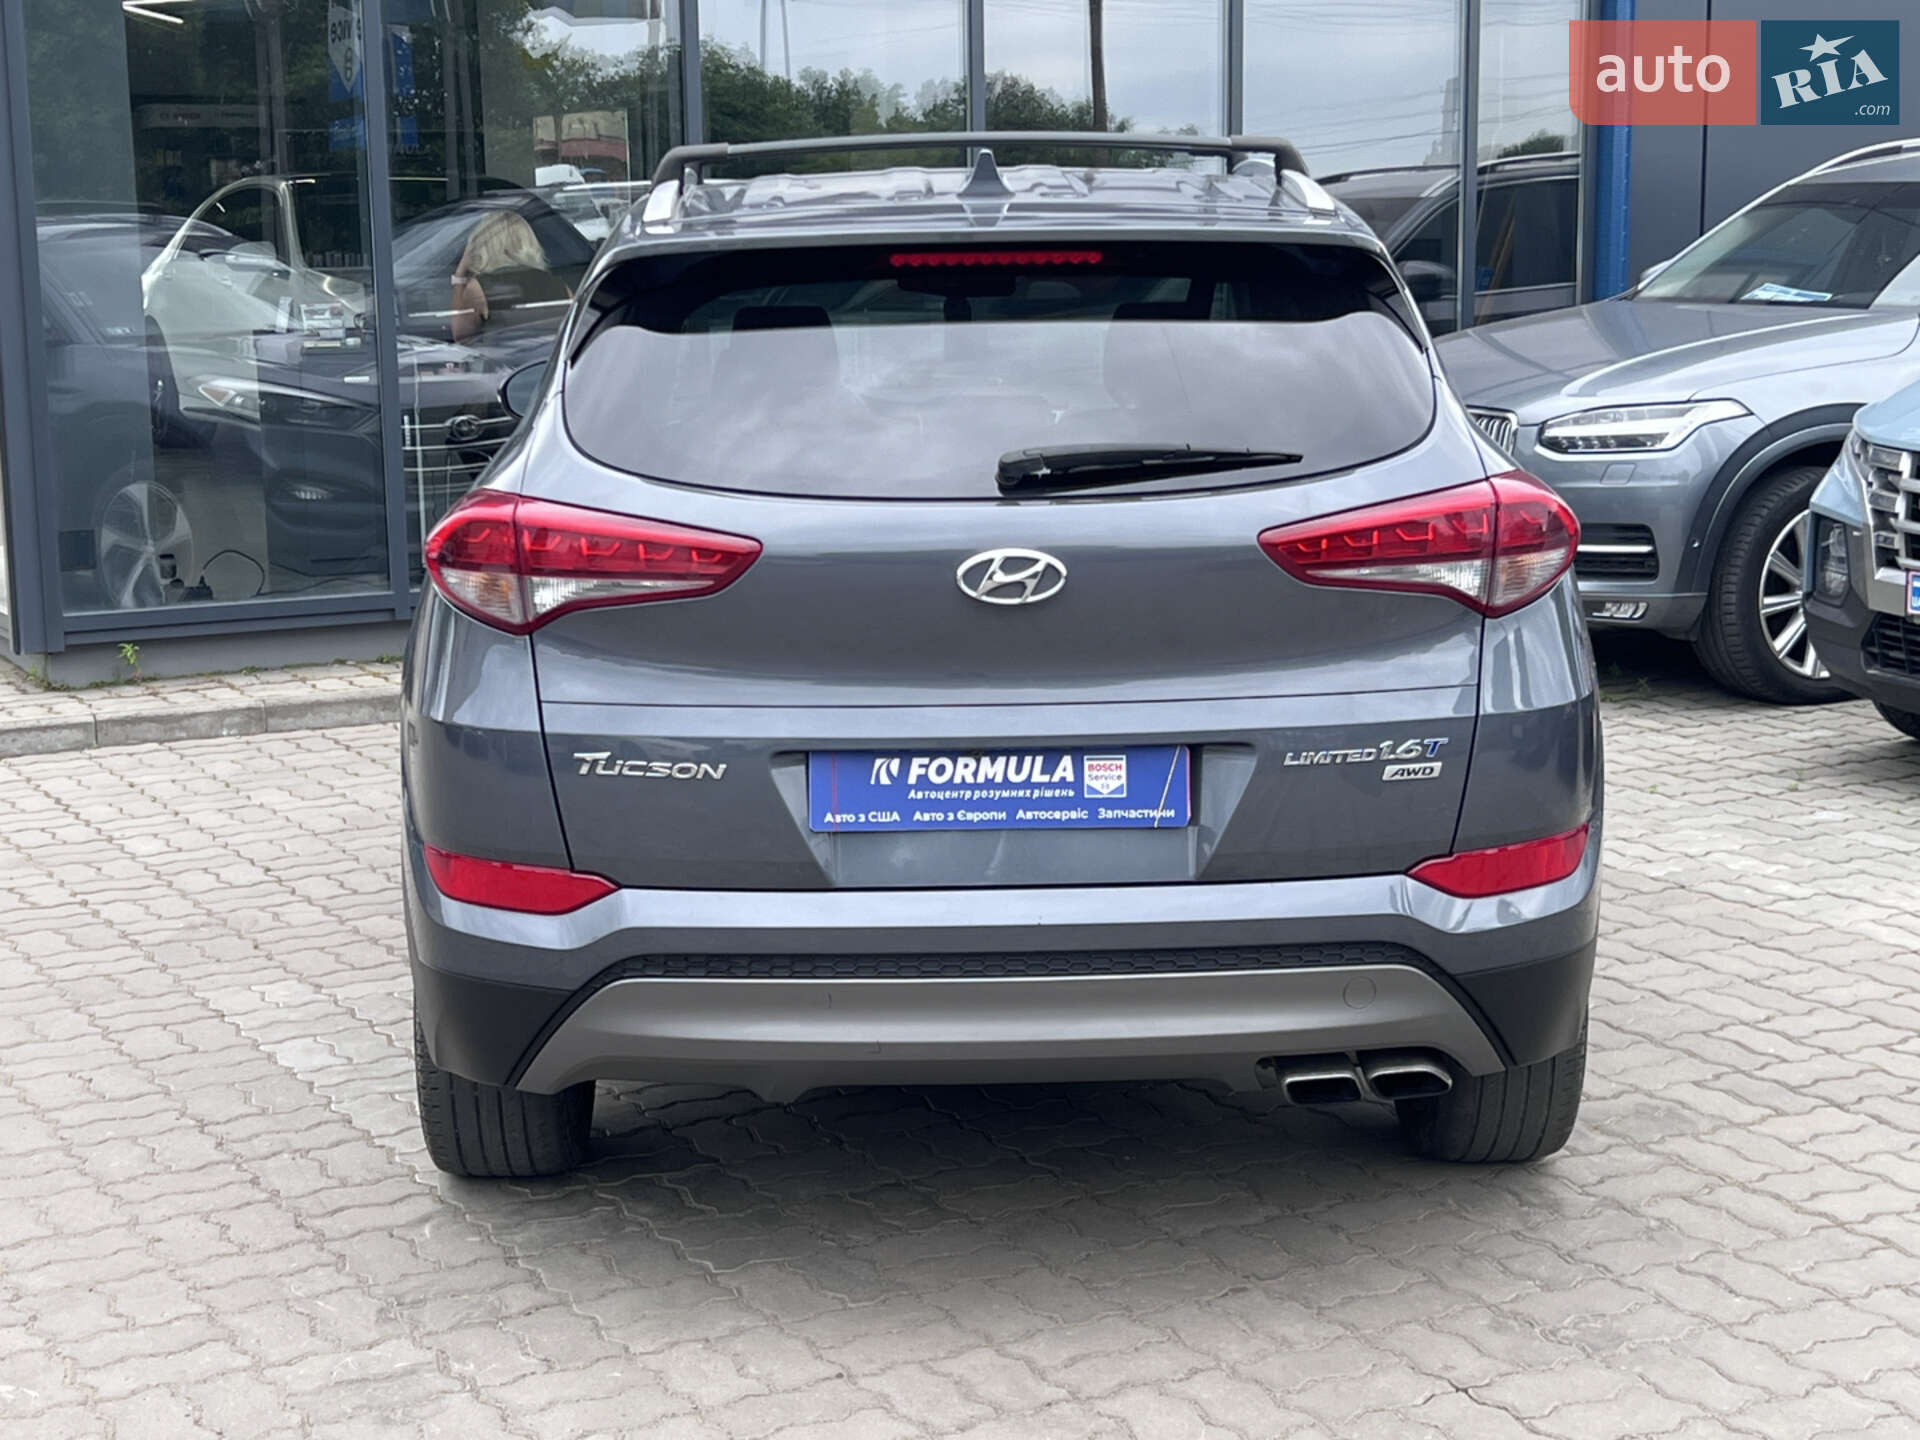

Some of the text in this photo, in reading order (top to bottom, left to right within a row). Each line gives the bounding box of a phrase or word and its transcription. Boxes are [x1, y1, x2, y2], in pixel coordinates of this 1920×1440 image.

[1283, 748, 1377, 766] LIMITED
[907, 755, 1075, 785] FORMULA
[1087, 763, 1123, 773] BOSCH
[1390, 766, 1434, 779] AWD
[1087, 773, 1123, 782] Service
[907, 787, 1075, 801] Автоцентр розумних рішень
[824, 812, 857, 825] Авто
[867, 810, 901, 823] США
[912, 810, 945, 823] Авто
[957, 809, 1007, 824] Європи
[1015, 808, 1089, 821] Автосервіс
[1097, 807, 1175, 820] Запчастини
